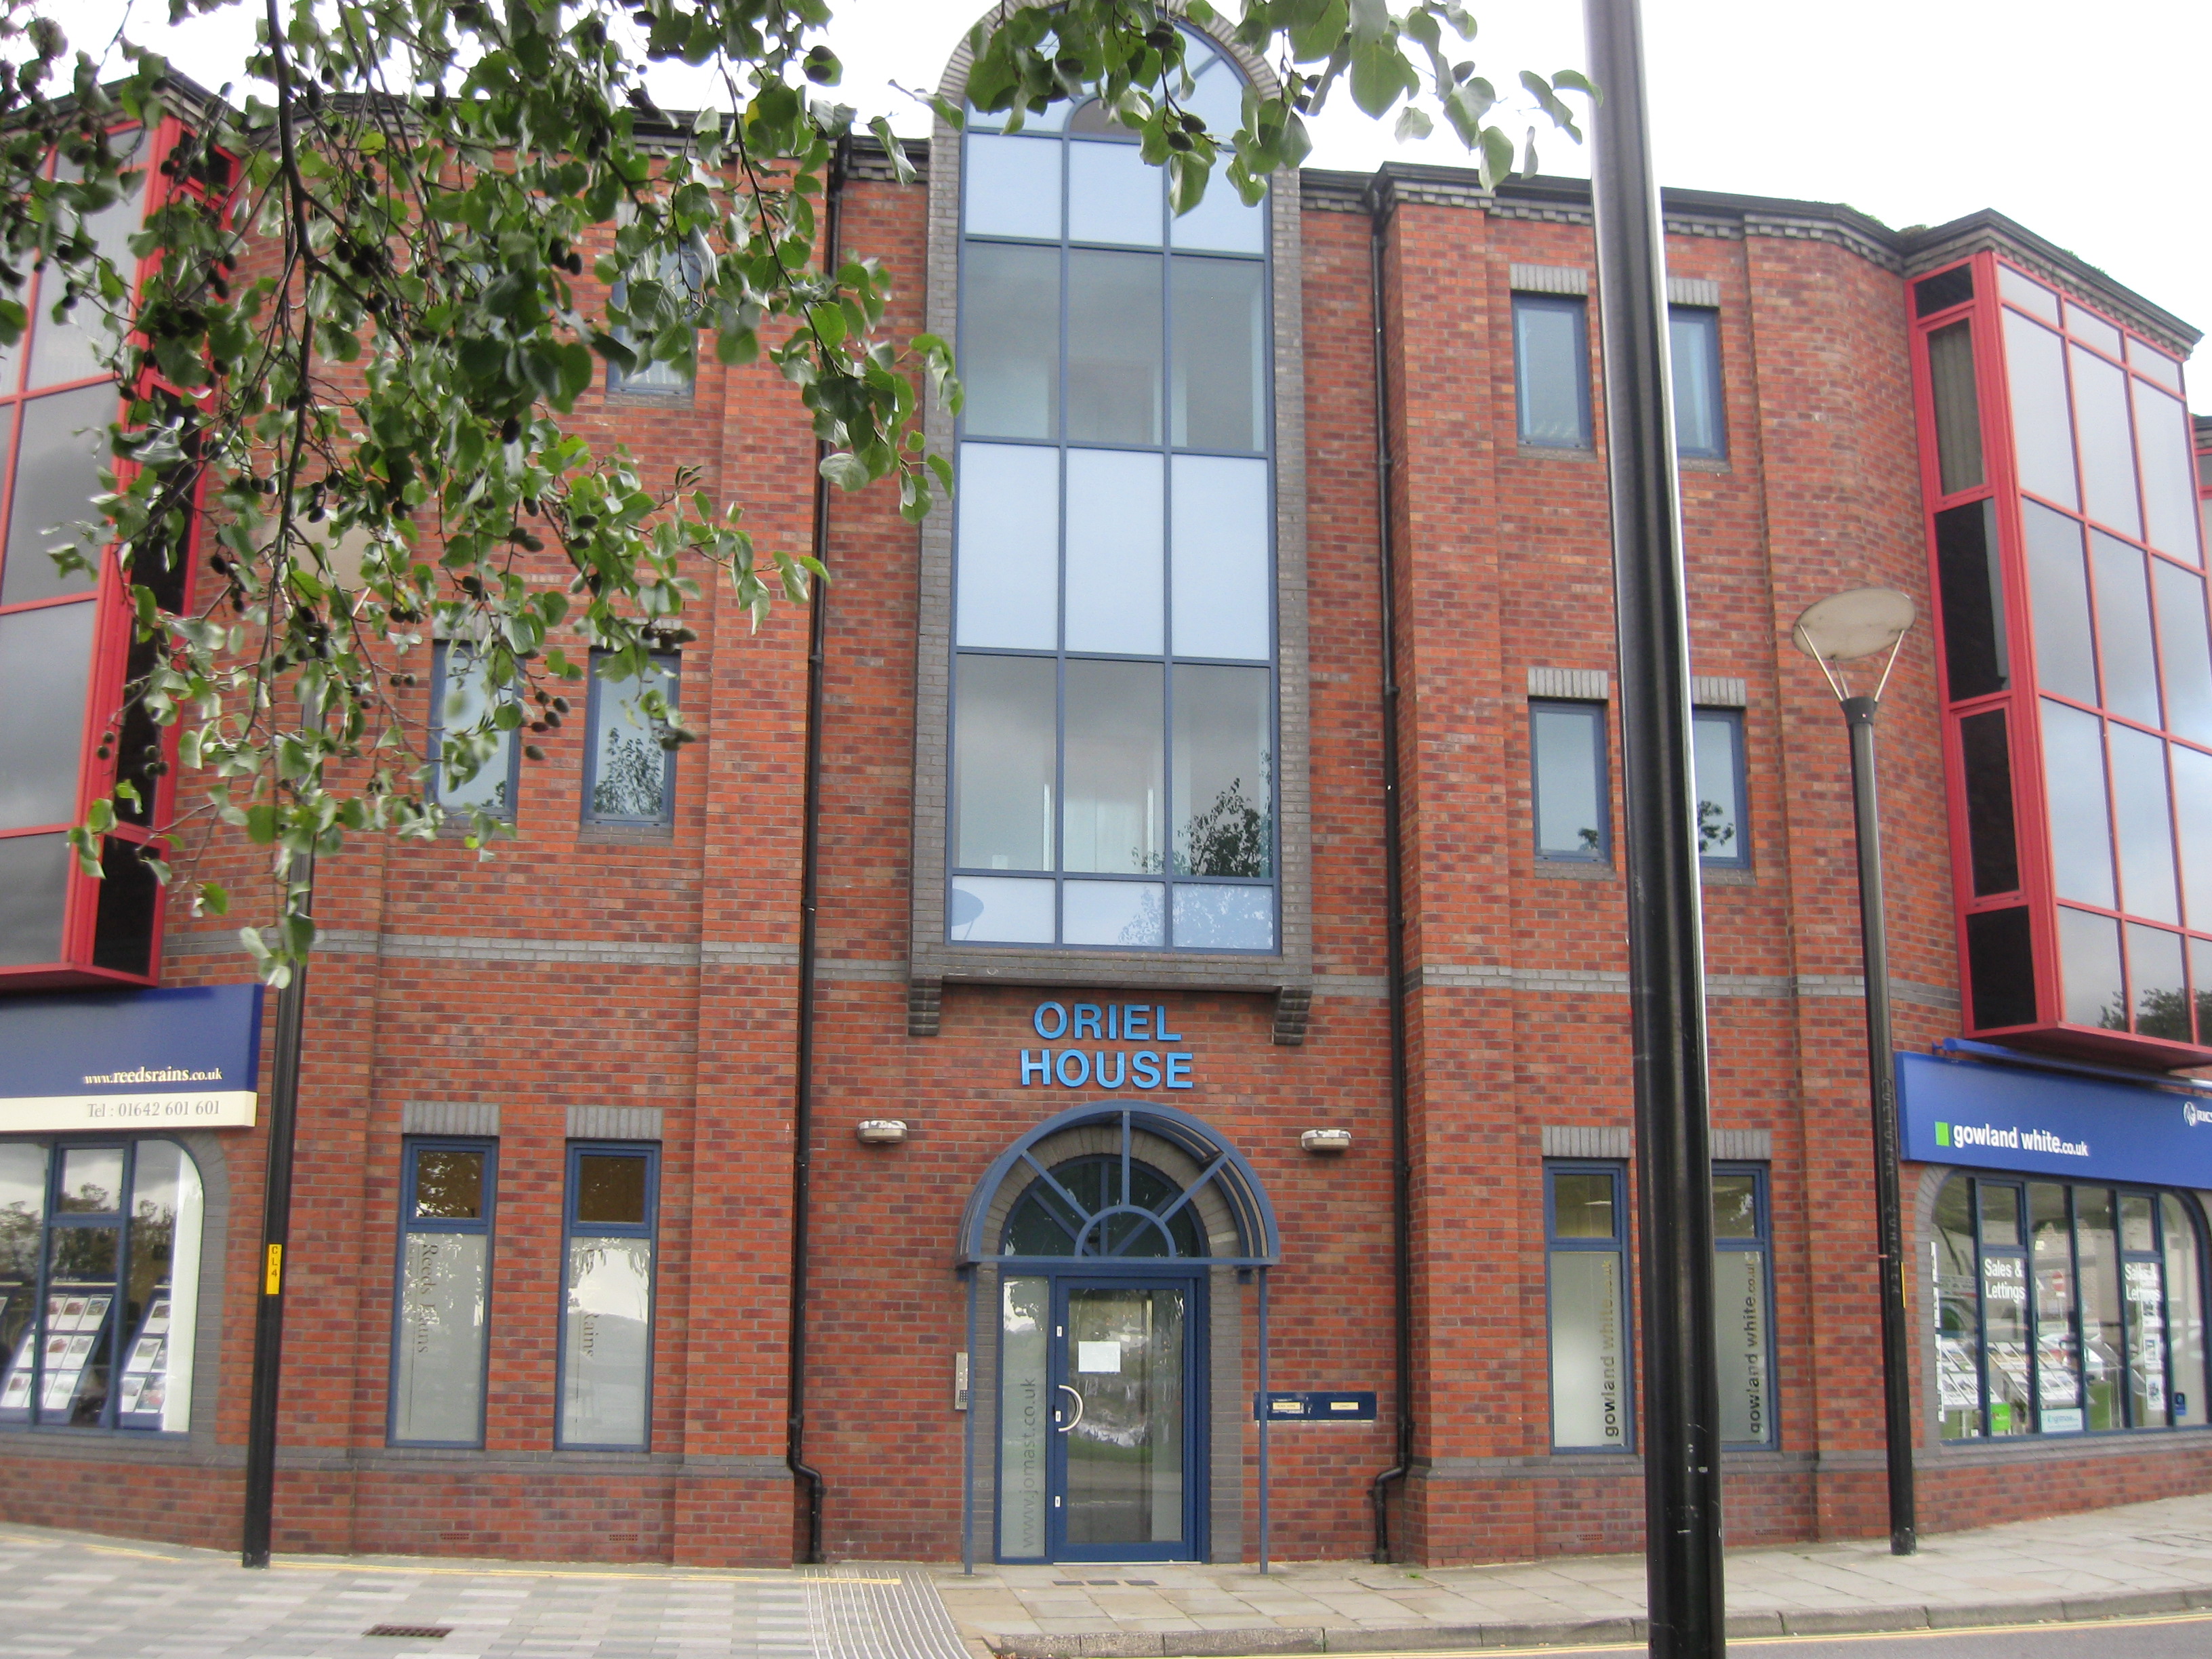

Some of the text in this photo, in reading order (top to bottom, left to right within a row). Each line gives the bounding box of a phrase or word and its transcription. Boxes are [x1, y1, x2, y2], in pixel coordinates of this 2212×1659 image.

[1033, 1000, 1182, 1042] ORIEL
[83, 1066, 222, 1084] www.reedsrains.co.uk
[1020, 1048, 1194, 1089] HOUSE
[119, 1101, 160, 1117] 01642
[165, 1101, 189, 1115] 601
[196, 1101, 220, 1115] 601
[1953, 1123, 2089, 1157] gowland white.co.uk
[419, 1244, 439, 1295] Reeds
[1984, 1258, 2023, 1278] Sales &
[1985, 1280, 2026, 1305] Lettings
[1599, 1259, 1619, 1437] gowland white.co.uk
[1744, 1353, 1761, 1434] gowland
[1019, 1377, 1038, 1549] www.jomast.co.uk
